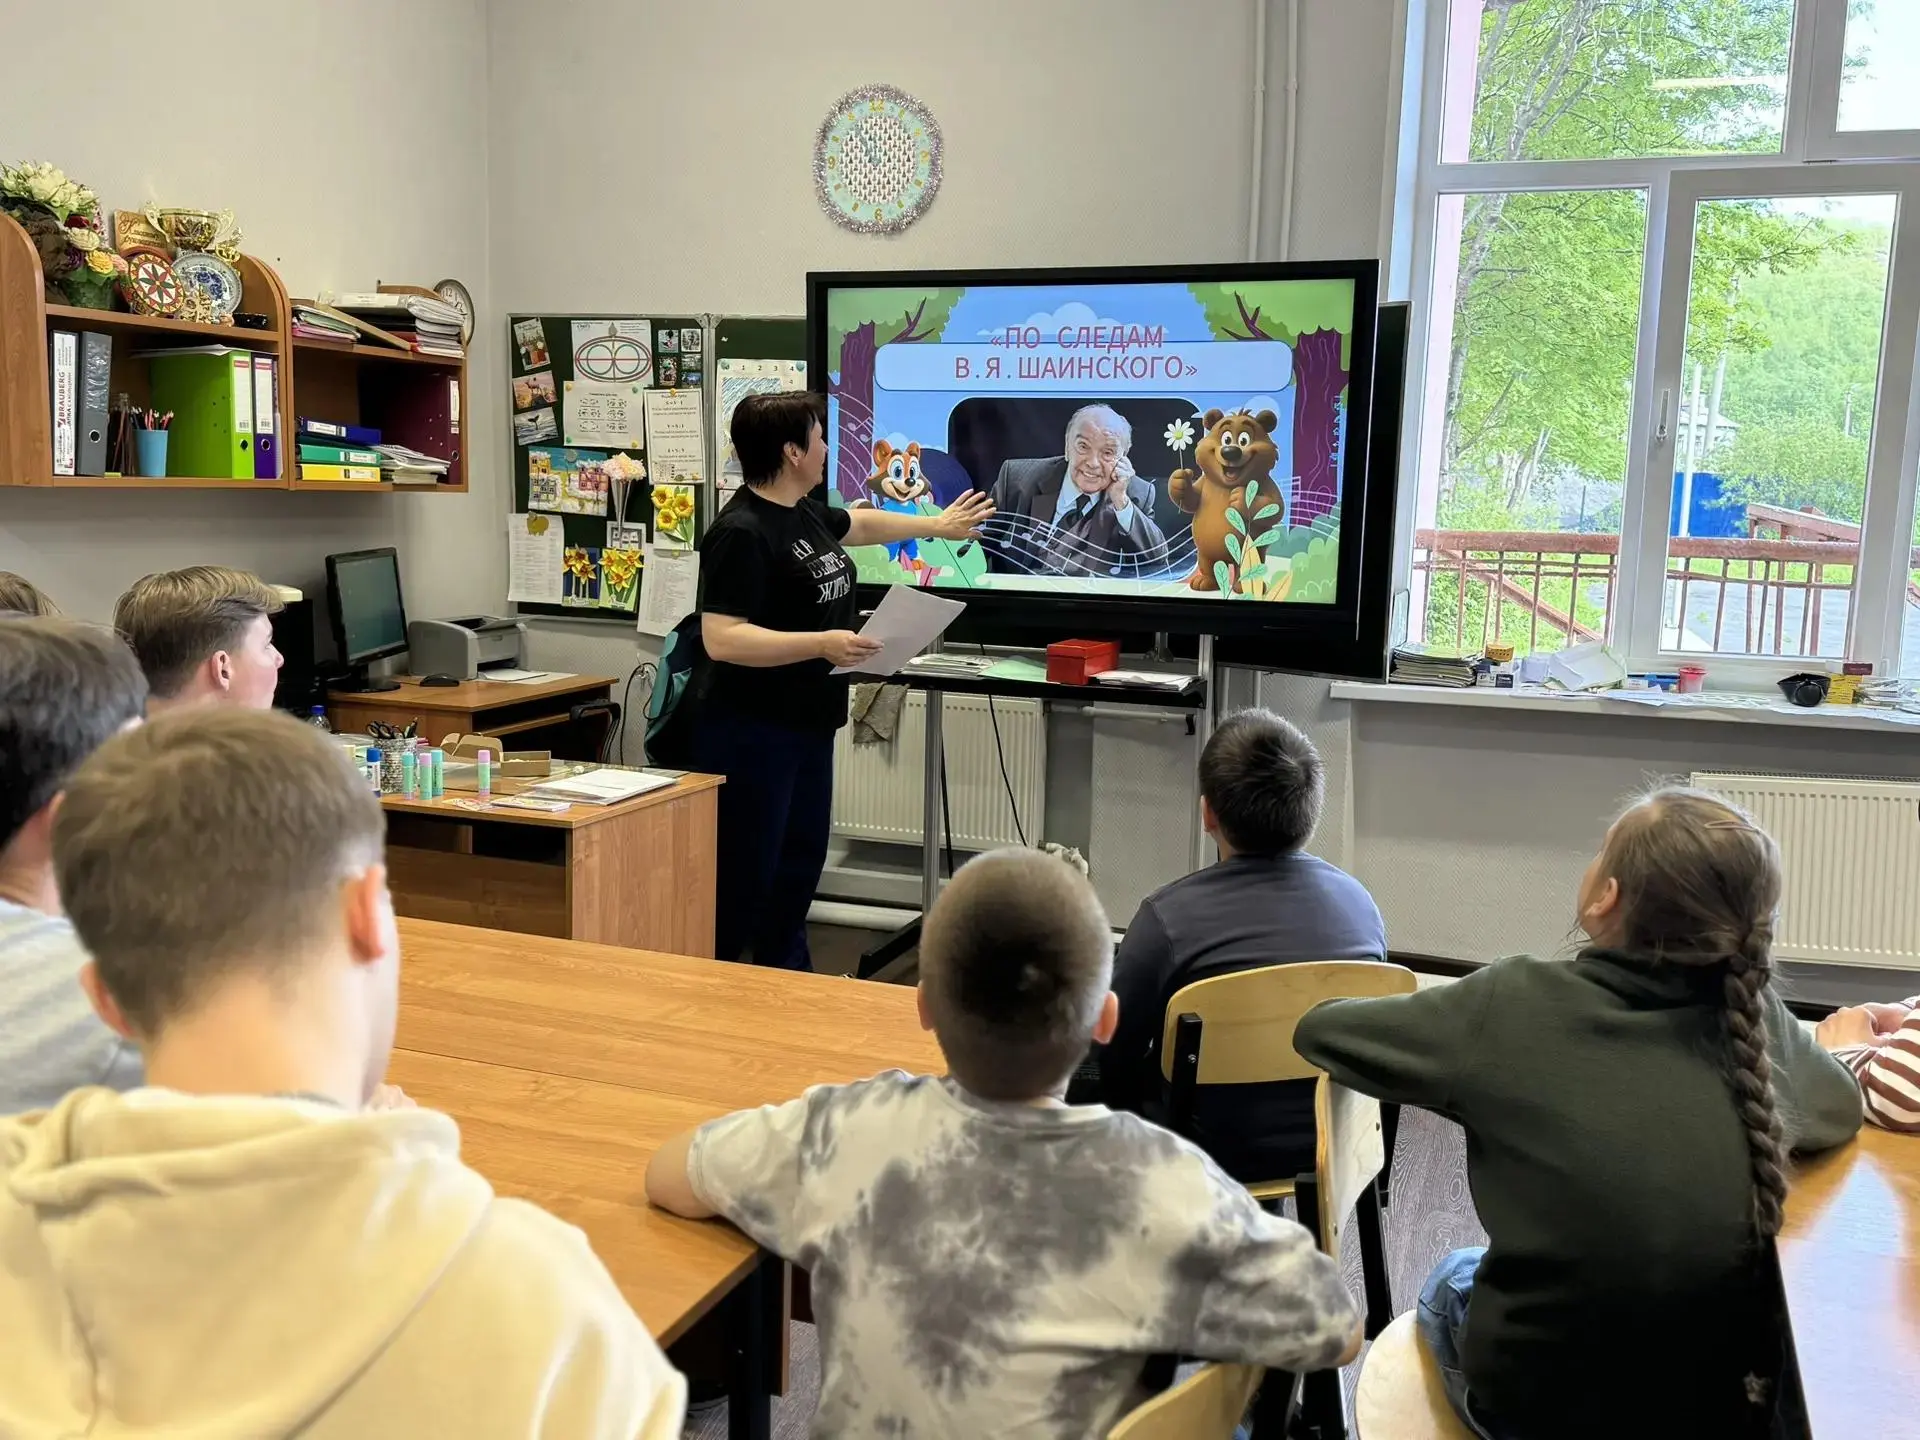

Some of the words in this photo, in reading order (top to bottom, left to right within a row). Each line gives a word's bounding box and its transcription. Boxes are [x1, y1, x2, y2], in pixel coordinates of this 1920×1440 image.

[991, 326, 1040, 349] «ПО
[1058, 325, 1163, 354] СЛЕДАМ
[792, 539, 815, 560] НА
